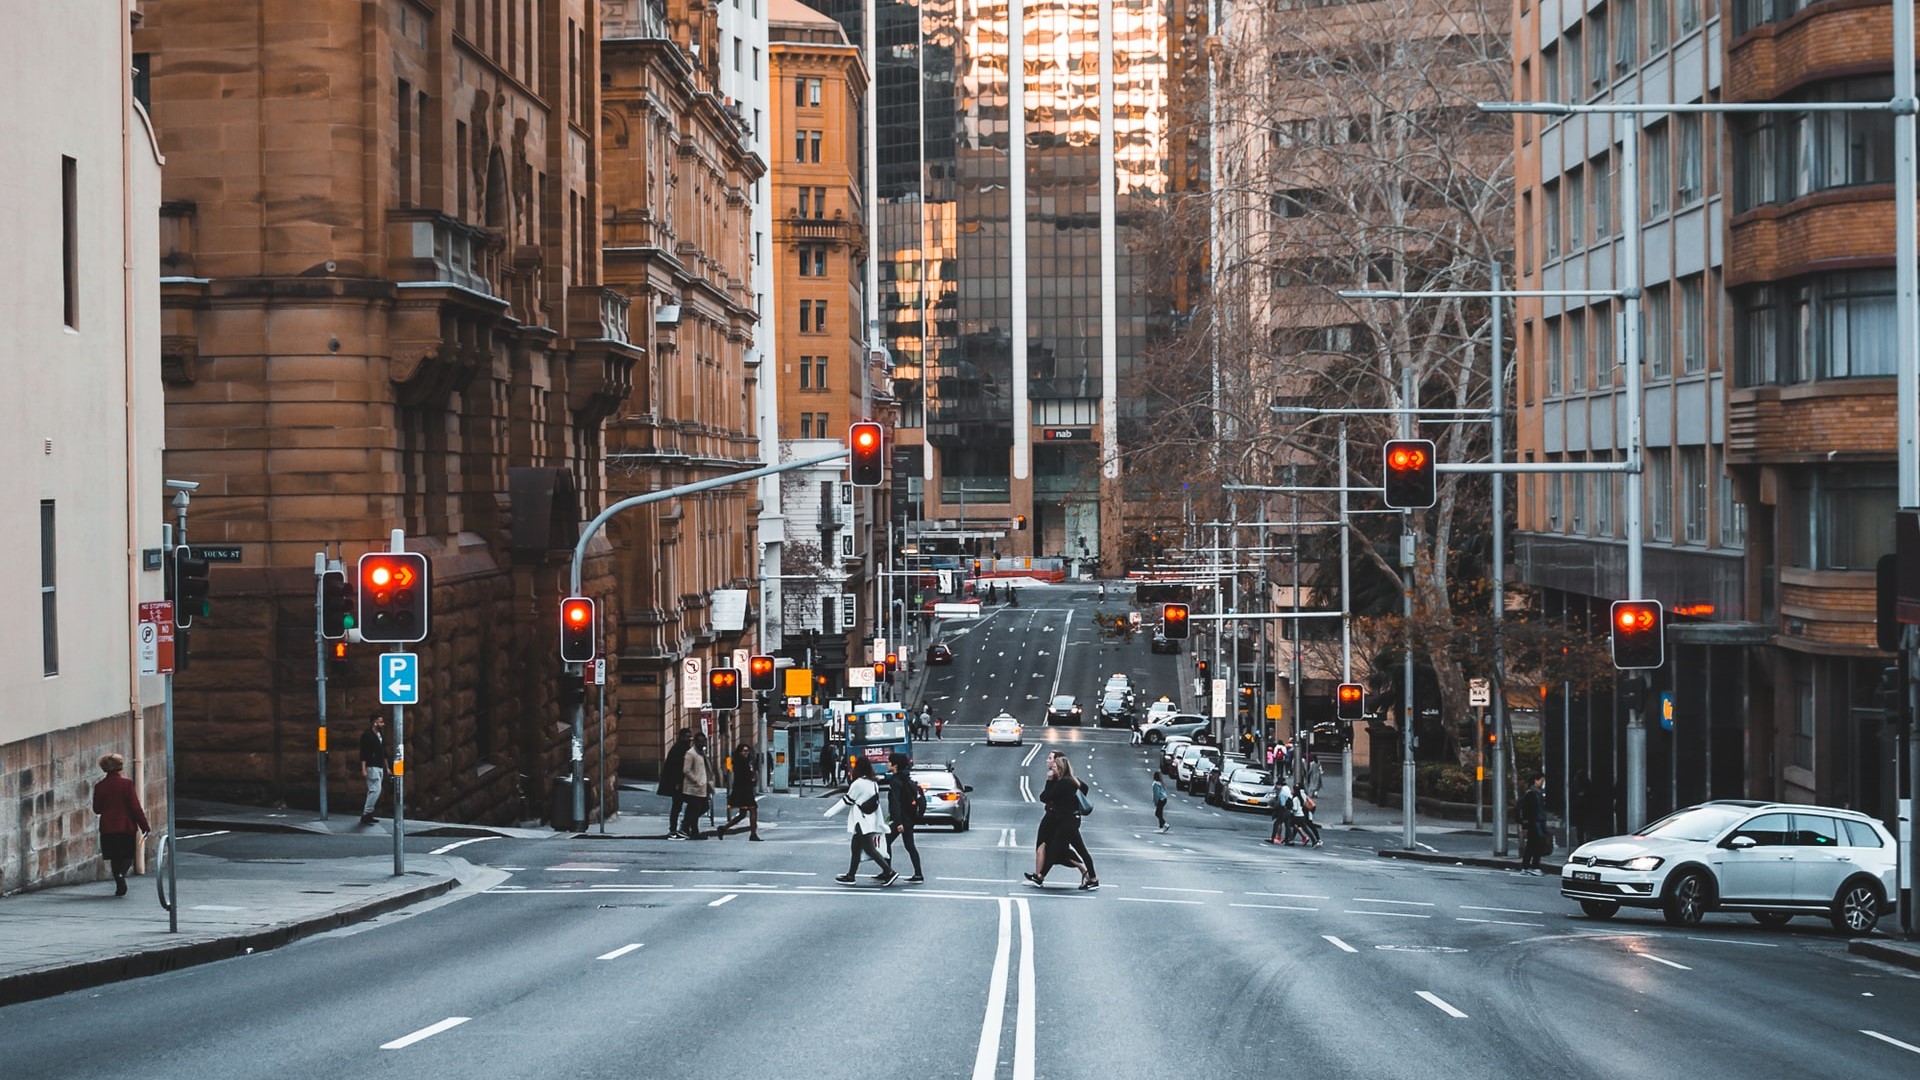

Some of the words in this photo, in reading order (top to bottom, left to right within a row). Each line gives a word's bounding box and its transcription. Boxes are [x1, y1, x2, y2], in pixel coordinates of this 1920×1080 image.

[203, 550, 228, 558] YOUNG
[230, 550, 240, 558] ST
[161, 625, 169, 634] NO
[390, 658, 407, 678] P
[864, 747, 884, 756] ICMS
